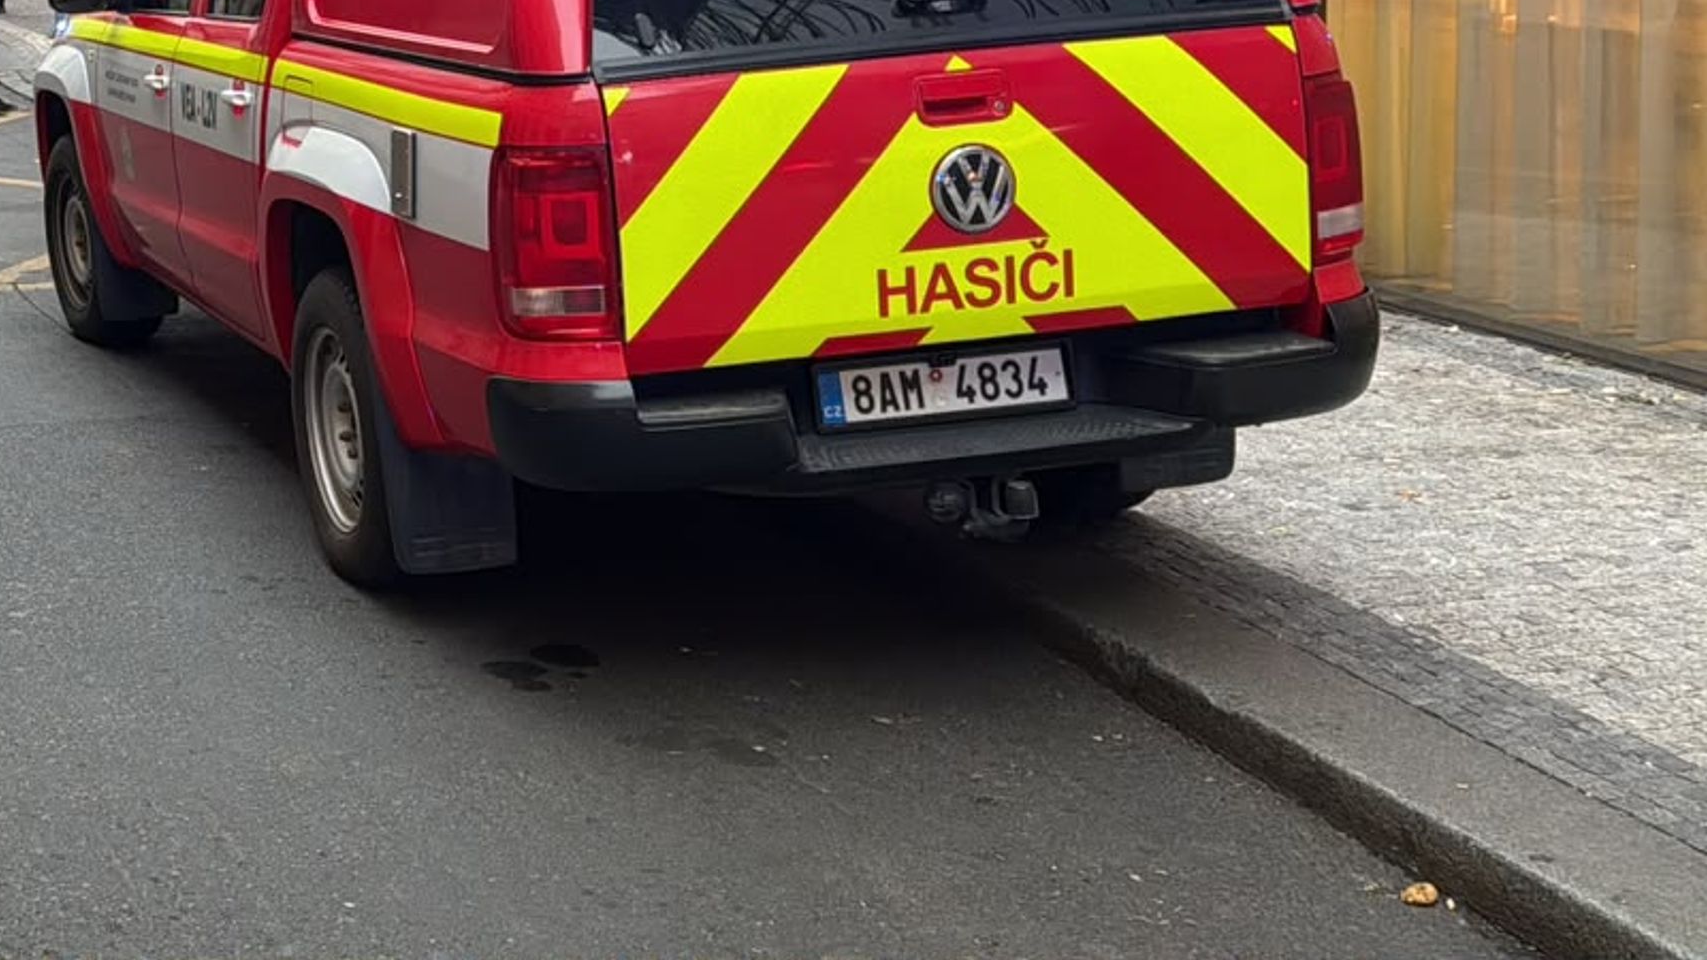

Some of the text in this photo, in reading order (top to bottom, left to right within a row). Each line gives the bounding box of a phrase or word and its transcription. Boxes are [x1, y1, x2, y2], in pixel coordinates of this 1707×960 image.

[877, 239, 1075, 319] HASIČI
[823, 356, 1049, 418] CZ 8AM 4834
